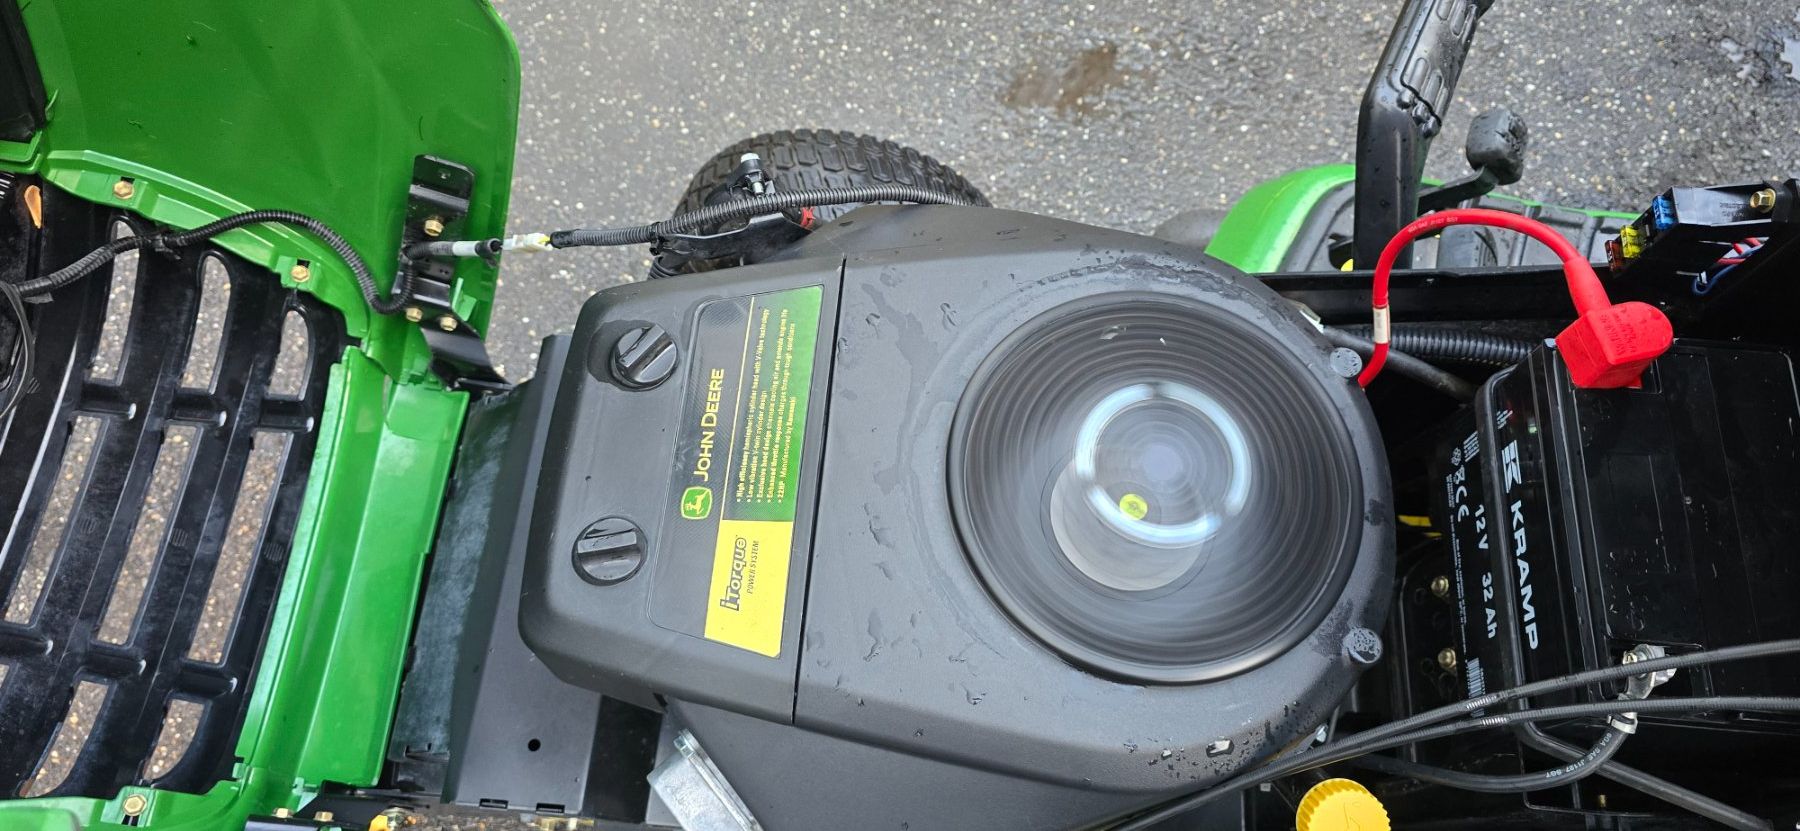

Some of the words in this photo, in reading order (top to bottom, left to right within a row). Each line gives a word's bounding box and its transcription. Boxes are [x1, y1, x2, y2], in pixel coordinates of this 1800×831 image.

[701, 369, 724, 427] DEERE
[759, 390, 767, 409] design
[757, 467, 766, 497] Exclusive
[763, 430, 771, 450] design
[770, 380, 778, 401] cooling
[693, 431, 715, 482] JOHN
[780, 434, 791, 477] Manufactured
[736, 482, 744, 497] High
[767, 467, 776, 498] Enhanced
[749, 541, 760, 568] SYSTEM
[720, 537, 746, 611] iTorque
[746, 570, 757, 594] POWER
[1481, 572, 1494, 602] 32
[1511, 500, 1539, 650] KRAMP
[1485, 608, 1498, 639] Ah
